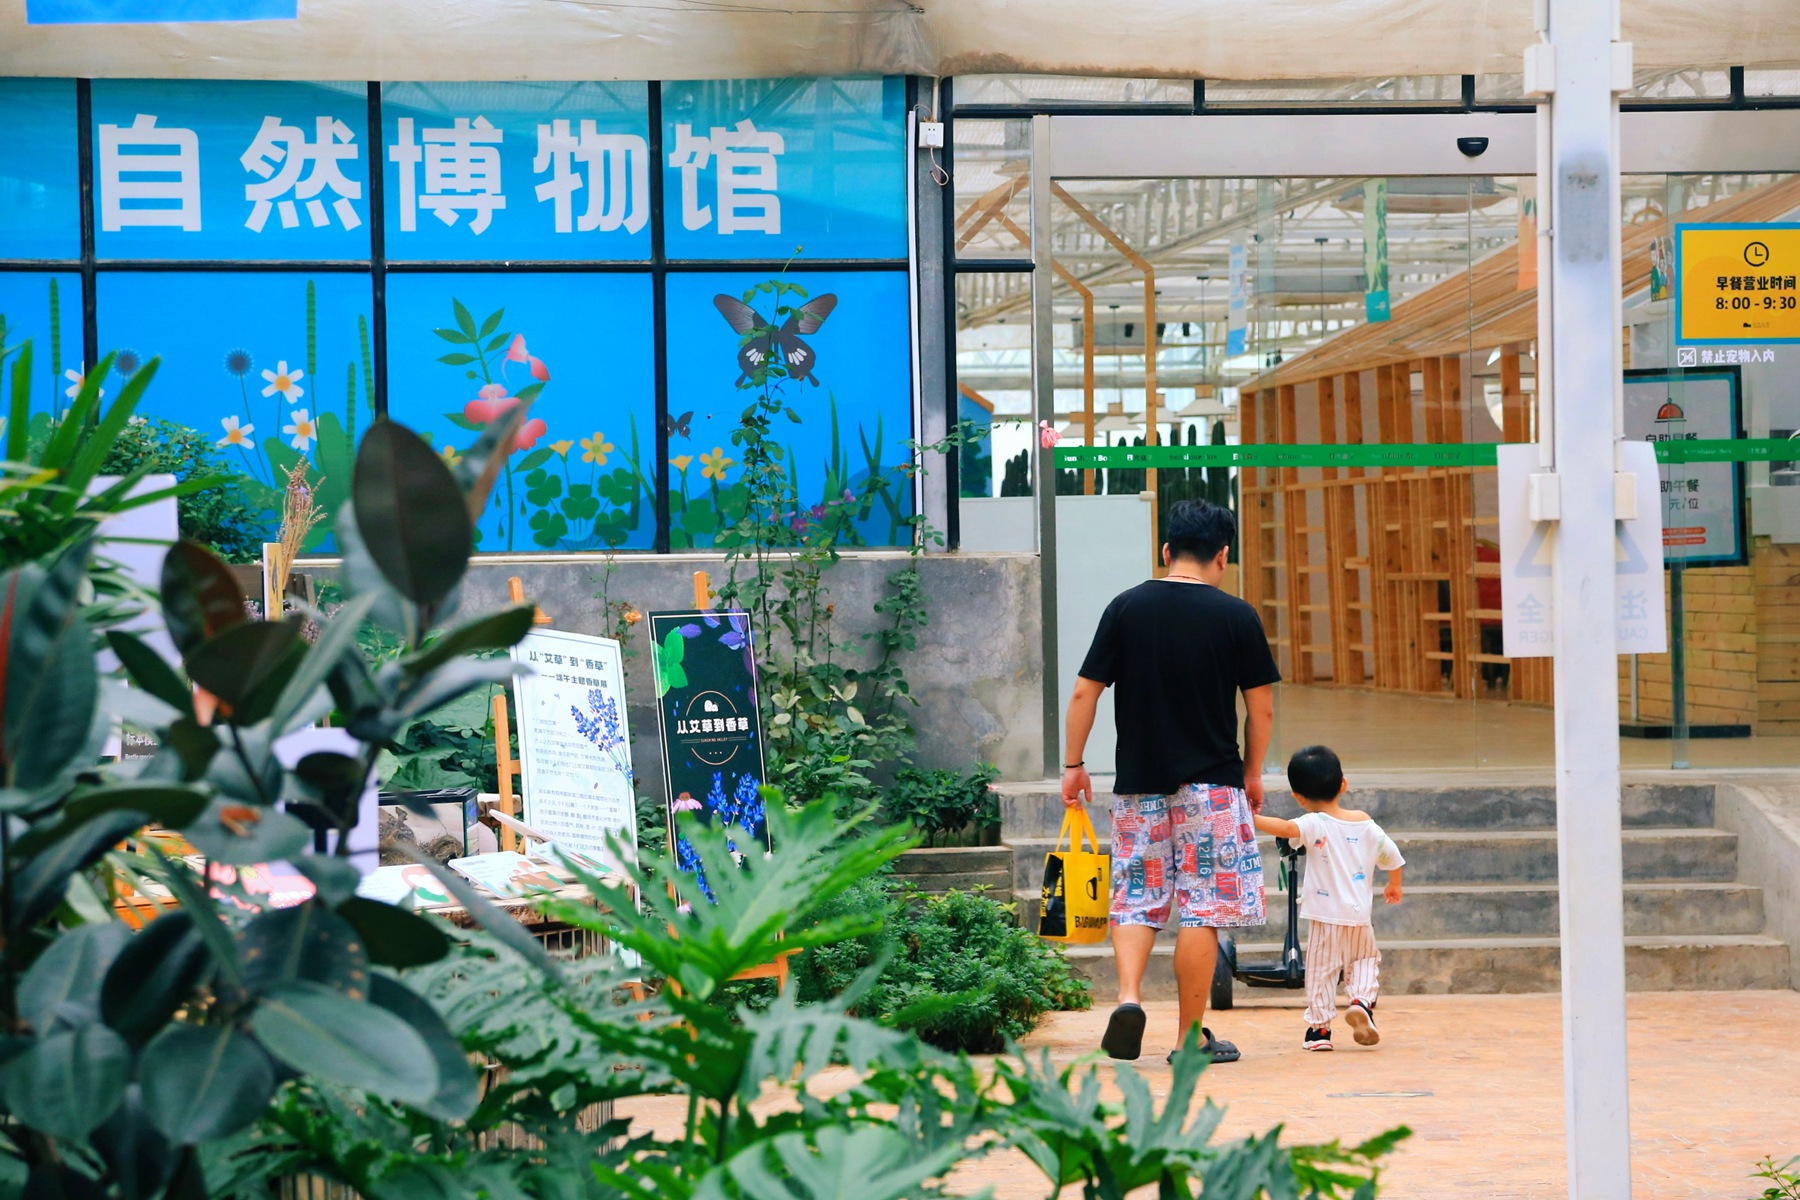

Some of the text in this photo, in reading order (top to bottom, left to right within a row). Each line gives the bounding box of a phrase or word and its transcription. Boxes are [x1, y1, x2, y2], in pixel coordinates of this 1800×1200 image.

[99, 113, 785, 236] 自然博物馆
[1716, 275, 1796, 291] 早餐营业时间
[1701, 348, 1775, 363] 禁止宠物入内
[676, 717, 749, 734] 从艾草到香草
[1198, 846, 1212, 875] 2116
[1131, 859, 1144, 885] 2116
